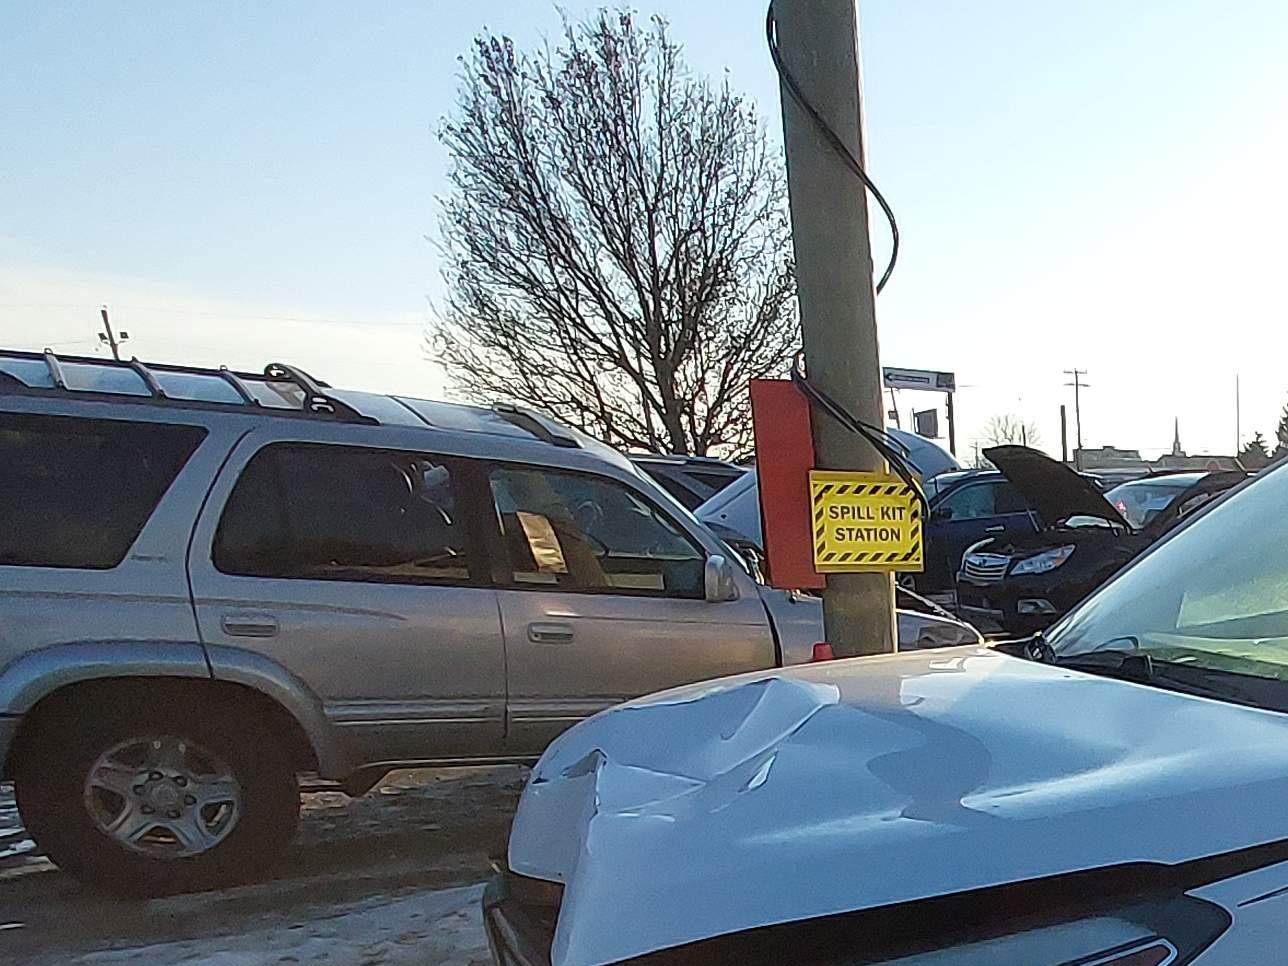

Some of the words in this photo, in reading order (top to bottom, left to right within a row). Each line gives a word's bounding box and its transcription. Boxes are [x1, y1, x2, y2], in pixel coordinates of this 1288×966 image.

[829, 505, 874, 521] SPILL
[880, 505, 905, 521] KIT
[834, 527, 900, 542] STATION
